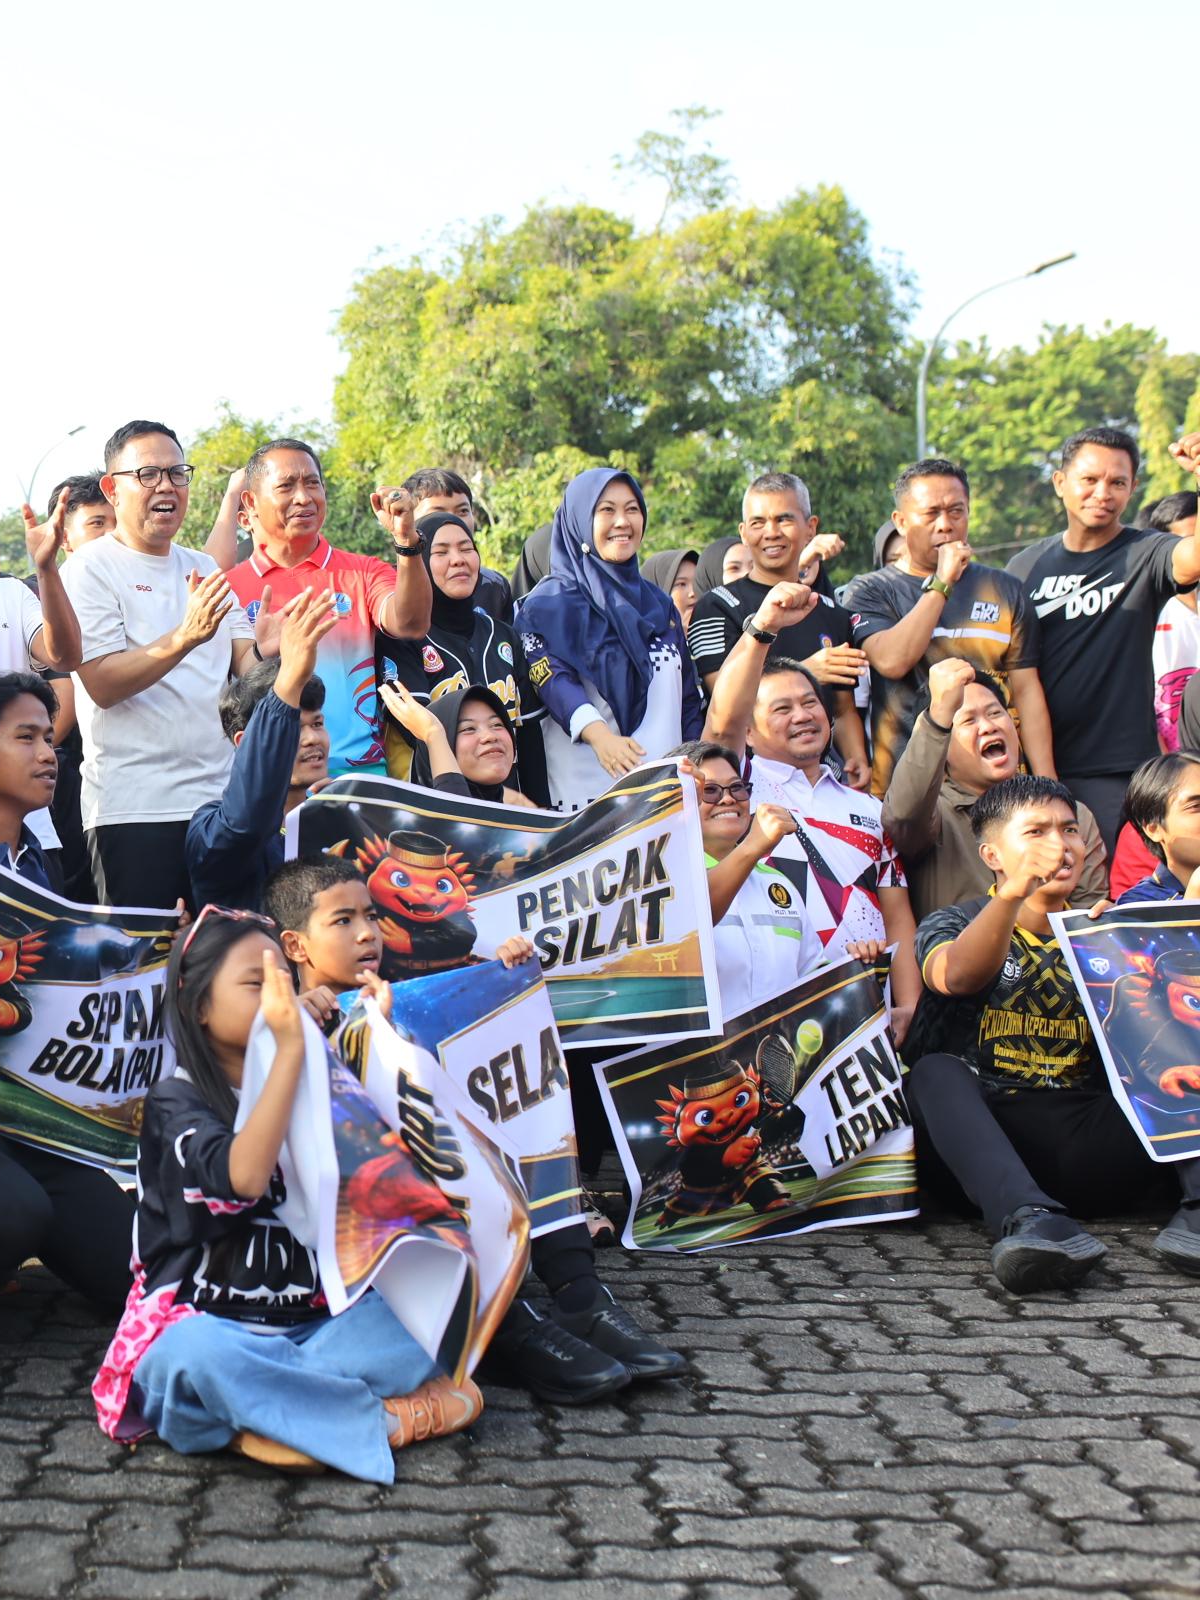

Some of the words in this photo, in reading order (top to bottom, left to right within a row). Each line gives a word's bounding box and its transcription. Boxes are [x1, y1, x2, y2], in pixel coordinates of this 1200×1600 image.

[970, 611, 1000, 623] BIKE
[972, 602, 1000, 614] FUN
[1066, 589, 1101, 620] DO
[517, 832, 671, 931] PENCAK
[534, 886, 675, 972] SILAT
[28, 1038, 125, 1094] BOLA
[467, 1026, 570, 1125] SELA
